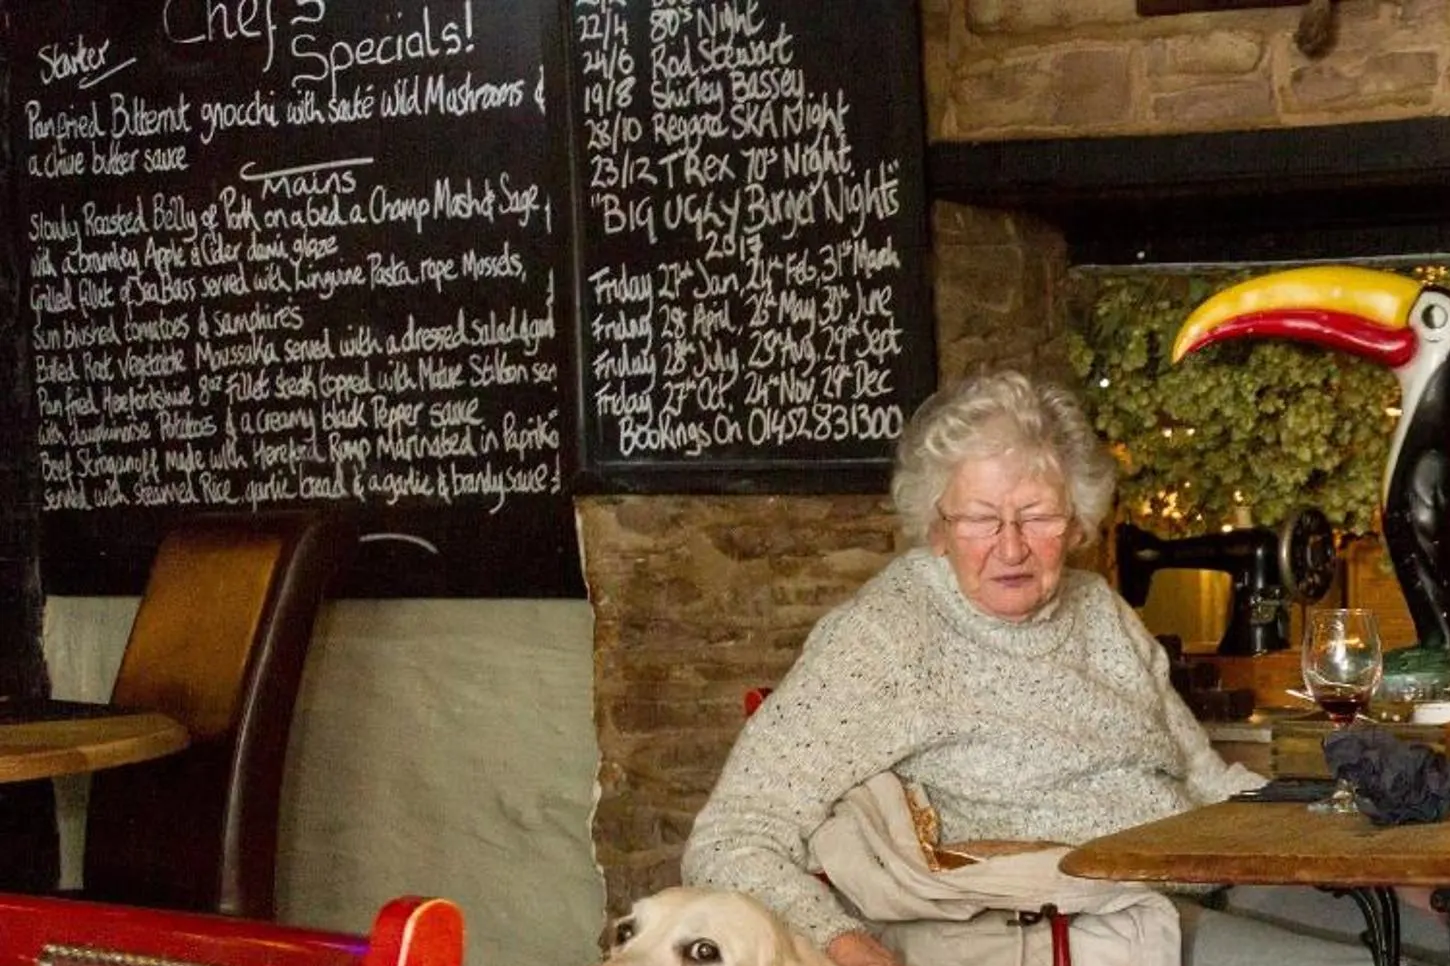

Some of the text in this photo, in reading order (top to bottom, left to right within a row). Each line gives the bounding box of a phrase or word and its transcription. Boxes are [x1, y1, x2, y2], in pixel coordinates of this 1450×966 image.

[290, 0, 475, 100] Specials!
[651, 35, 700, 80] Rod
[698, 22, 794, 72] Stewart
[200, 90, 279, 144] gnocchi
[287, 90, 325, 124] with
[730, 102, 779, 140] SKA
[782, 88, 850, 150] Night
[92, 140, 136, 176] butter
[144, 145, 189, 173] sauce
[262, 172, 357, 200] Mains
[29, 203, 81, 255] Slowly
[83, 195, 150, 237] Roasted
[153, 192, 197, 243] Belly
[264, 208, 289, 229] on
[306, 194, 349, 226] bed
[370, 185, 430, 234] Champ
[433, 177, 480, 219] Mash
[587, 262, 655, 316] Friday
[591, 309, 654, 349] Friday
[592, 342, 656, 395] Friday
[595, 380, 654, 427] Friday
[851, 360, 895, 399] Dec
[480, 425, 500, 454] in
